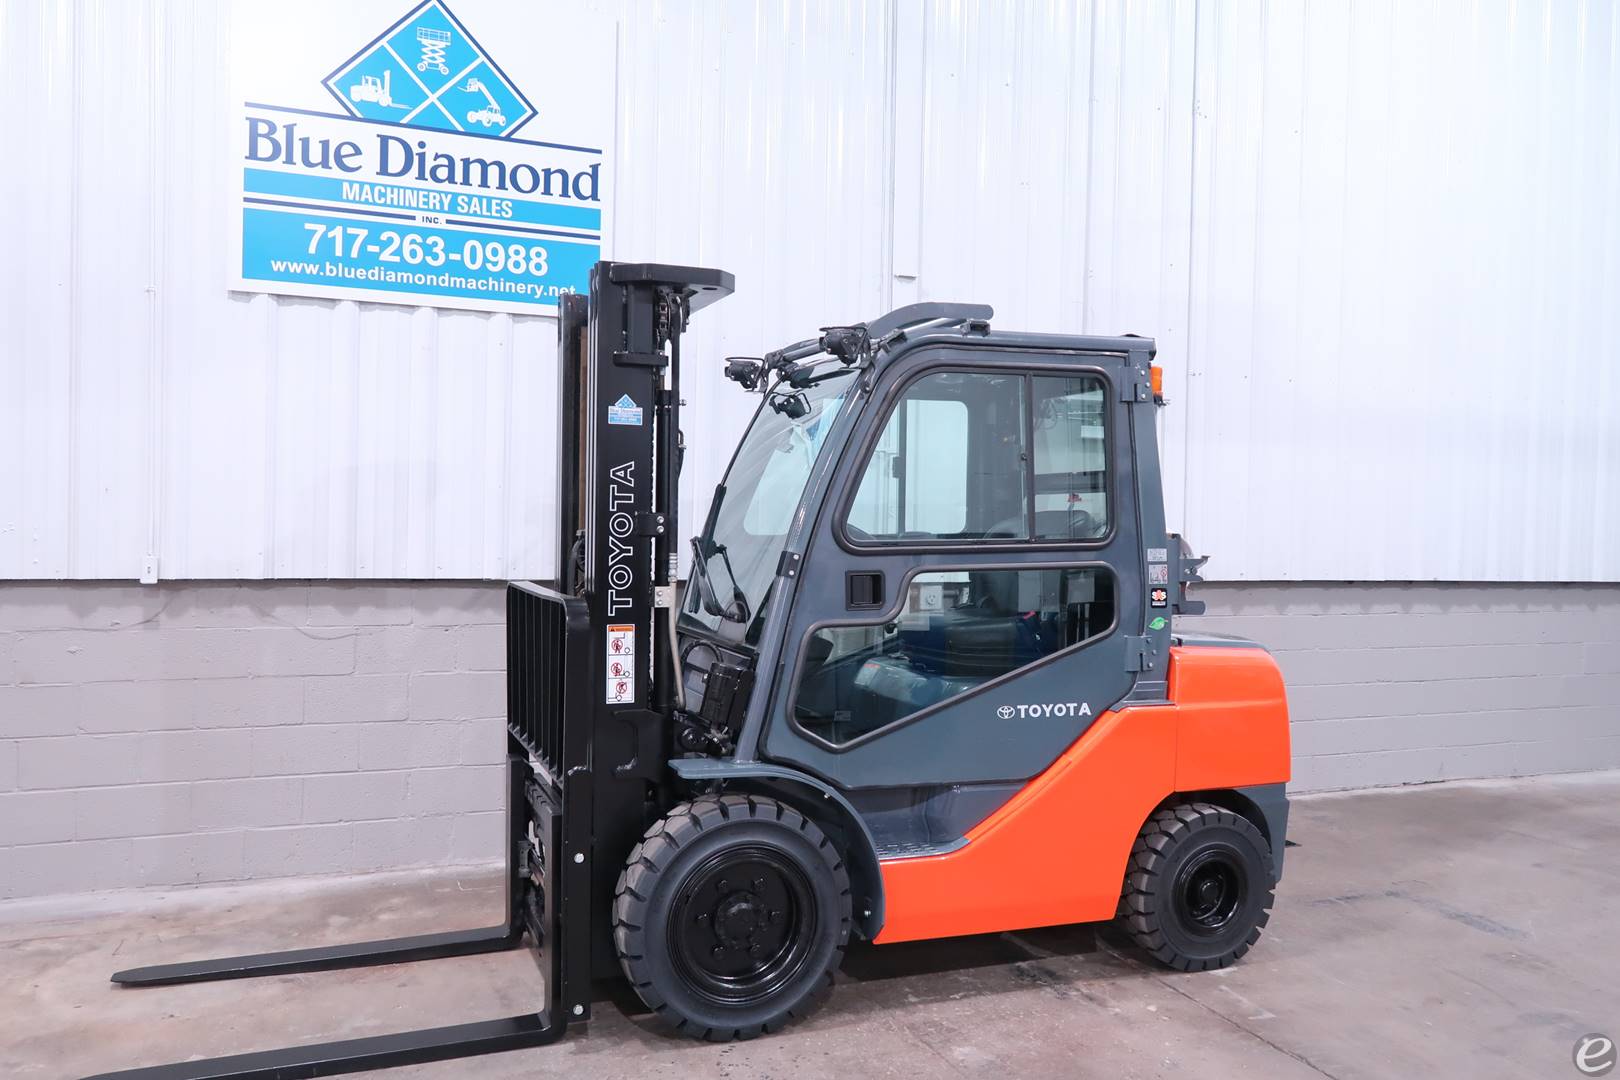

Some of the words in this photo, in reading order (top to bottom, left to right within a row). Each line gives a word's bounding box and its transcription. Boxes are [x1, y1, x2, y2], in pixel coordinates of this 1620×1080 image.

[245, 118, 363, 173] Blue
[376, 134, 601, 201] Diamond
[342, 182, 451, 211] MACHINERY
[457, 195, 513, 219] SALES
[421, 215, 443, 225] INC.
[303, 223, 548, 276] 717-263-0988
[271, 259, 576, 299] www.bluediamondmachinery.net
[608, 461, 635, 616] TOYOTA
[1017, 702, 1091, 718] TOYOTA
